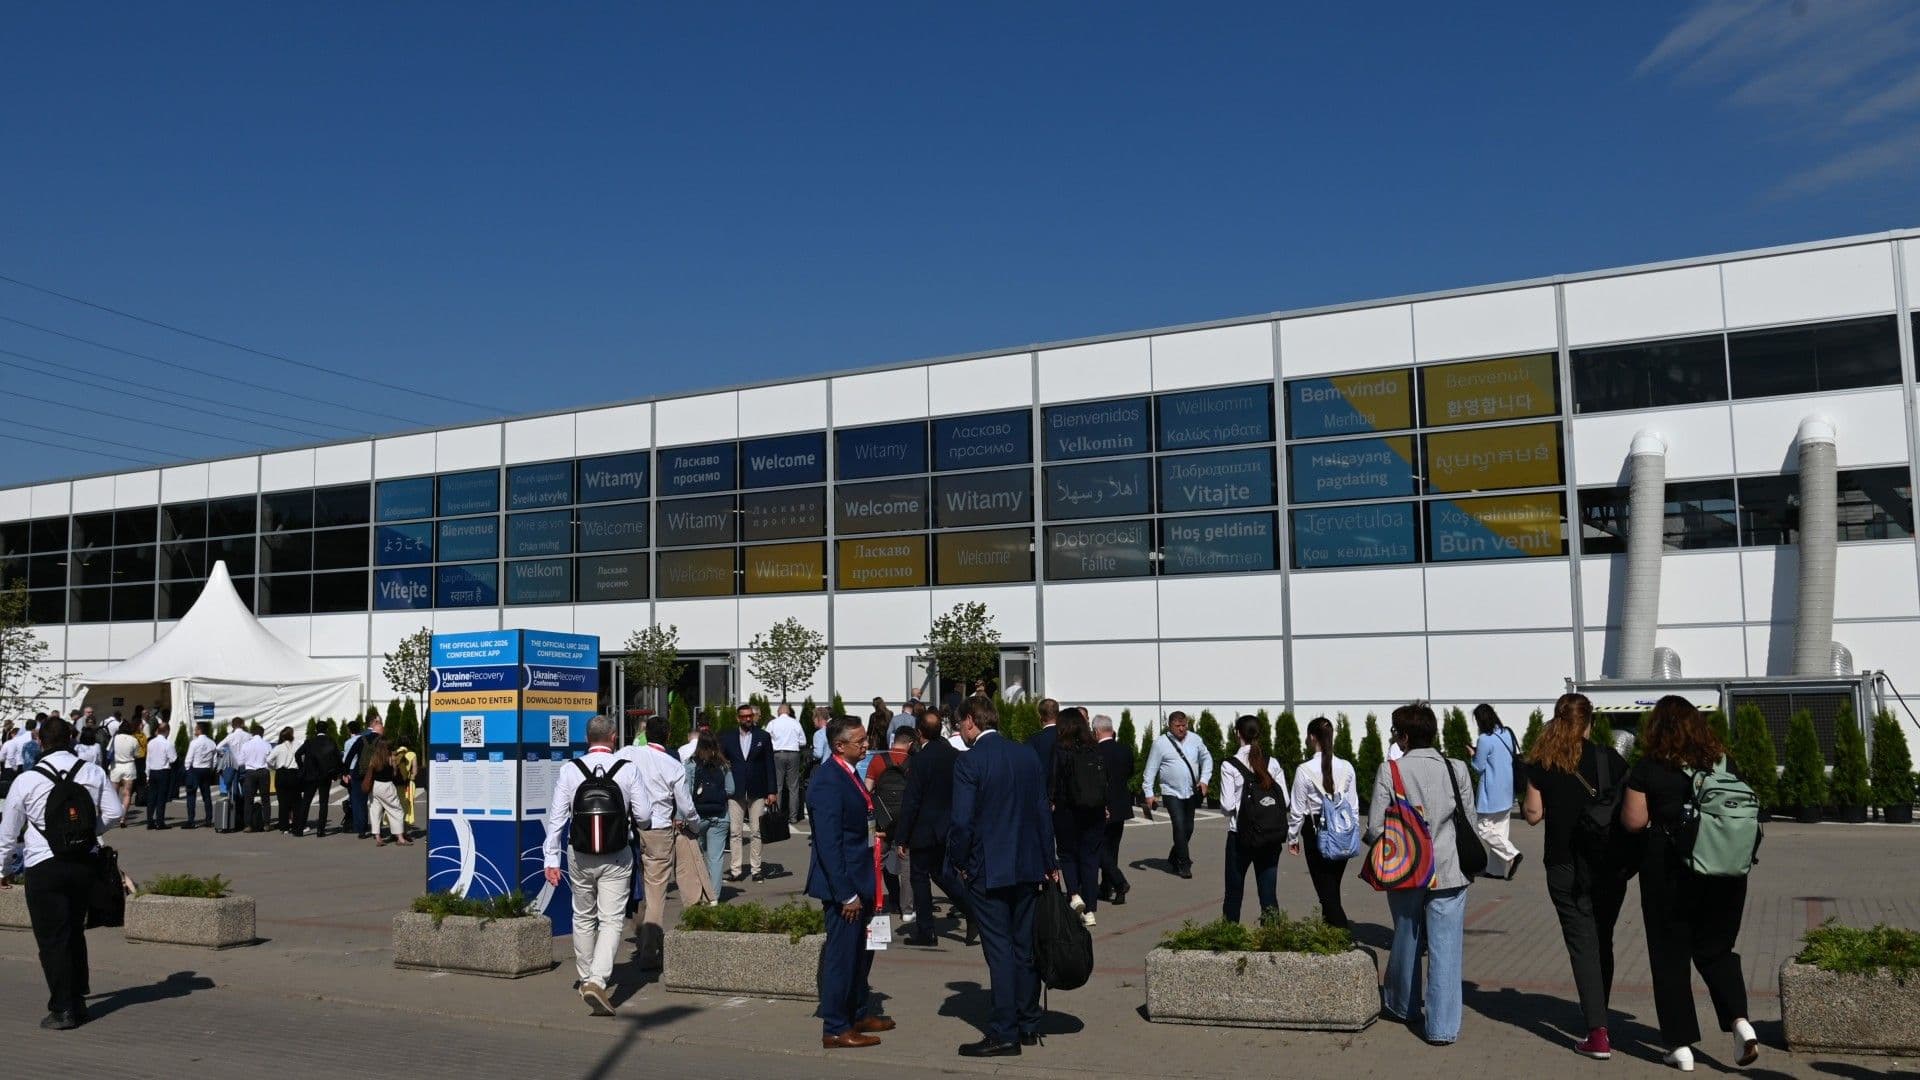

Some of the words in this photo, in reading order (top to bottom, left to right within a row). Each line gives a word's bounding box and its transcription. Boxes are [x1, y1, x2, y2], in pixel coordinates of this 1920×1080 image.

[1301, 380, 1397, 402] Bem-vindo
[1052, 408, 1140, 428] Bienvenidos
[952, 424, 1011, 440] Ласкаво
[855, 442, 908, 461] Witamy
[949, 442, 1014, 459] просимо
[1059, 433, 1134, 453] Velkomin
[674, 454, 720, 469] Ласкаво
[751, 453, 816, 471] Welcome
[1311, 450, 1392, 469] Maligayang
[584, 471, 643, 489] Witamy
[673, 471, 720, 486] просимо
[1317, 470, 1388, 490] pagdating
[946, 490, 1023, 512] Witamy
[1183, 483, 1250, 505] Vitajte
[845, 499, 920, 517] Welcome
[583, 519, 644, 536] Welcome
[668, 511, 727, 531] Witamy
[1304, 508, 1403, 531] Tervetuloa
[441, 524, 494, 537] Bienvenue
[1171, 525, 1200, 542] Hoş
[1204, 521, 1267, 541] geldiniz
[1491, 527, 1552, 551] venit
[384, 536, 425, 552] ようこそ
[854, 543, 910, 559] Ласкаво
[957, 550, 1011, 567] Welcome
[515, 563, 563, 577] Welkom
[669, 563, 726, 583] Welcome
[754, 560, 815, 580] Witamy
[852, 566, 912, 582] просимо
[452, 641, 479, 649] OFFICIAL
[480, 640, 491, 648] URC
[531, 639, 541, 648] THE
[542, 641, 565, 649] OFFICIAL
[446, 651, 487, 659] CONFERENCE
[537, 650, 571, 659] CONFERENCE
[435, 697, 476, 706] DOWNLOAD
[477, 697, 487, 705] TO
[489, 696, 513, 704] ENTER
[526, 696, 562, 705] DOWNLOAD
[564, 697, 573, 705] TO
[573, 697, 593, 705] ENTER
